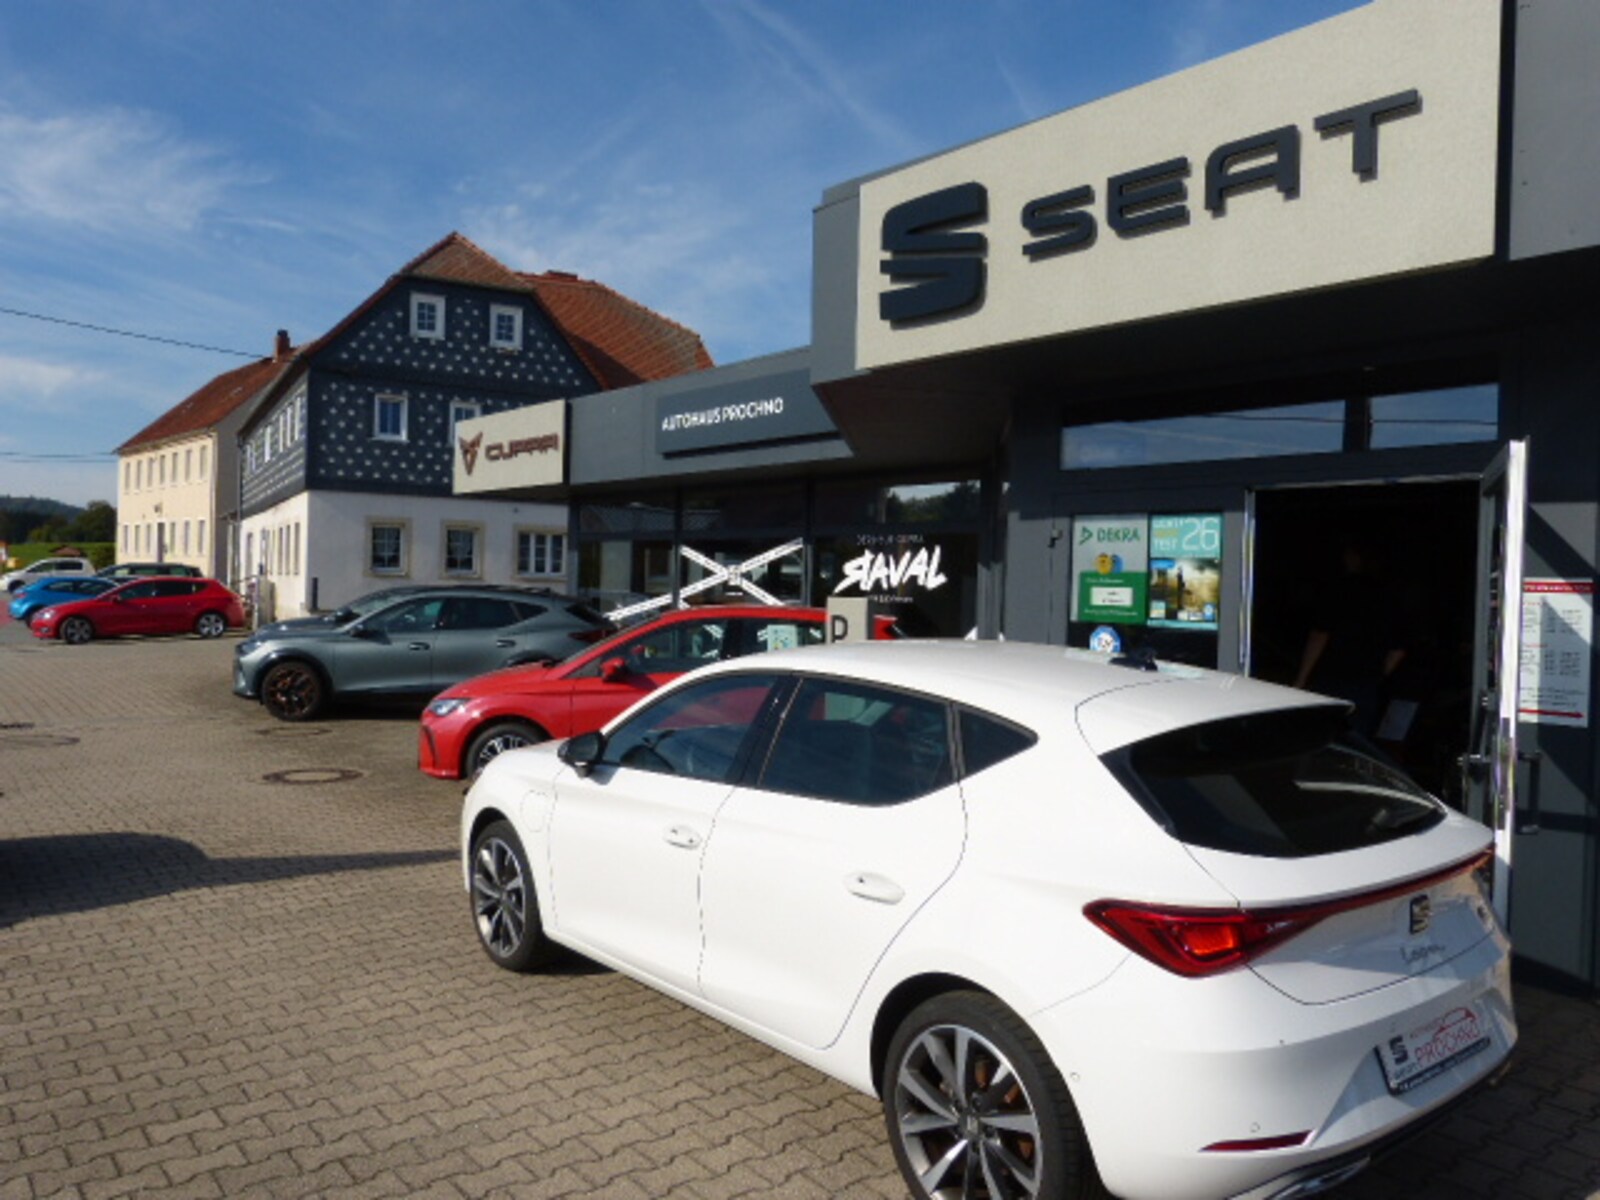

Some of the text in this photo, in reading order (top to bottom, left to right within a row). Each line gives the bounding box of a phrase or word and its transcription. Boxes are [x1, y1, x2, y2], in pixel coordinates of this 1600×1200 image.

[1021, 89, 1424, 262] SEAT
[661, 397, 784, 431] AUTOHAUS PROCHNO
[484, 432, 560, 461] CUPRA
[1097, 527, 1141, 543] DEKRA
[1181, 517, 1219, 551] 26
[833, 545, 949, 595] RAVAL
